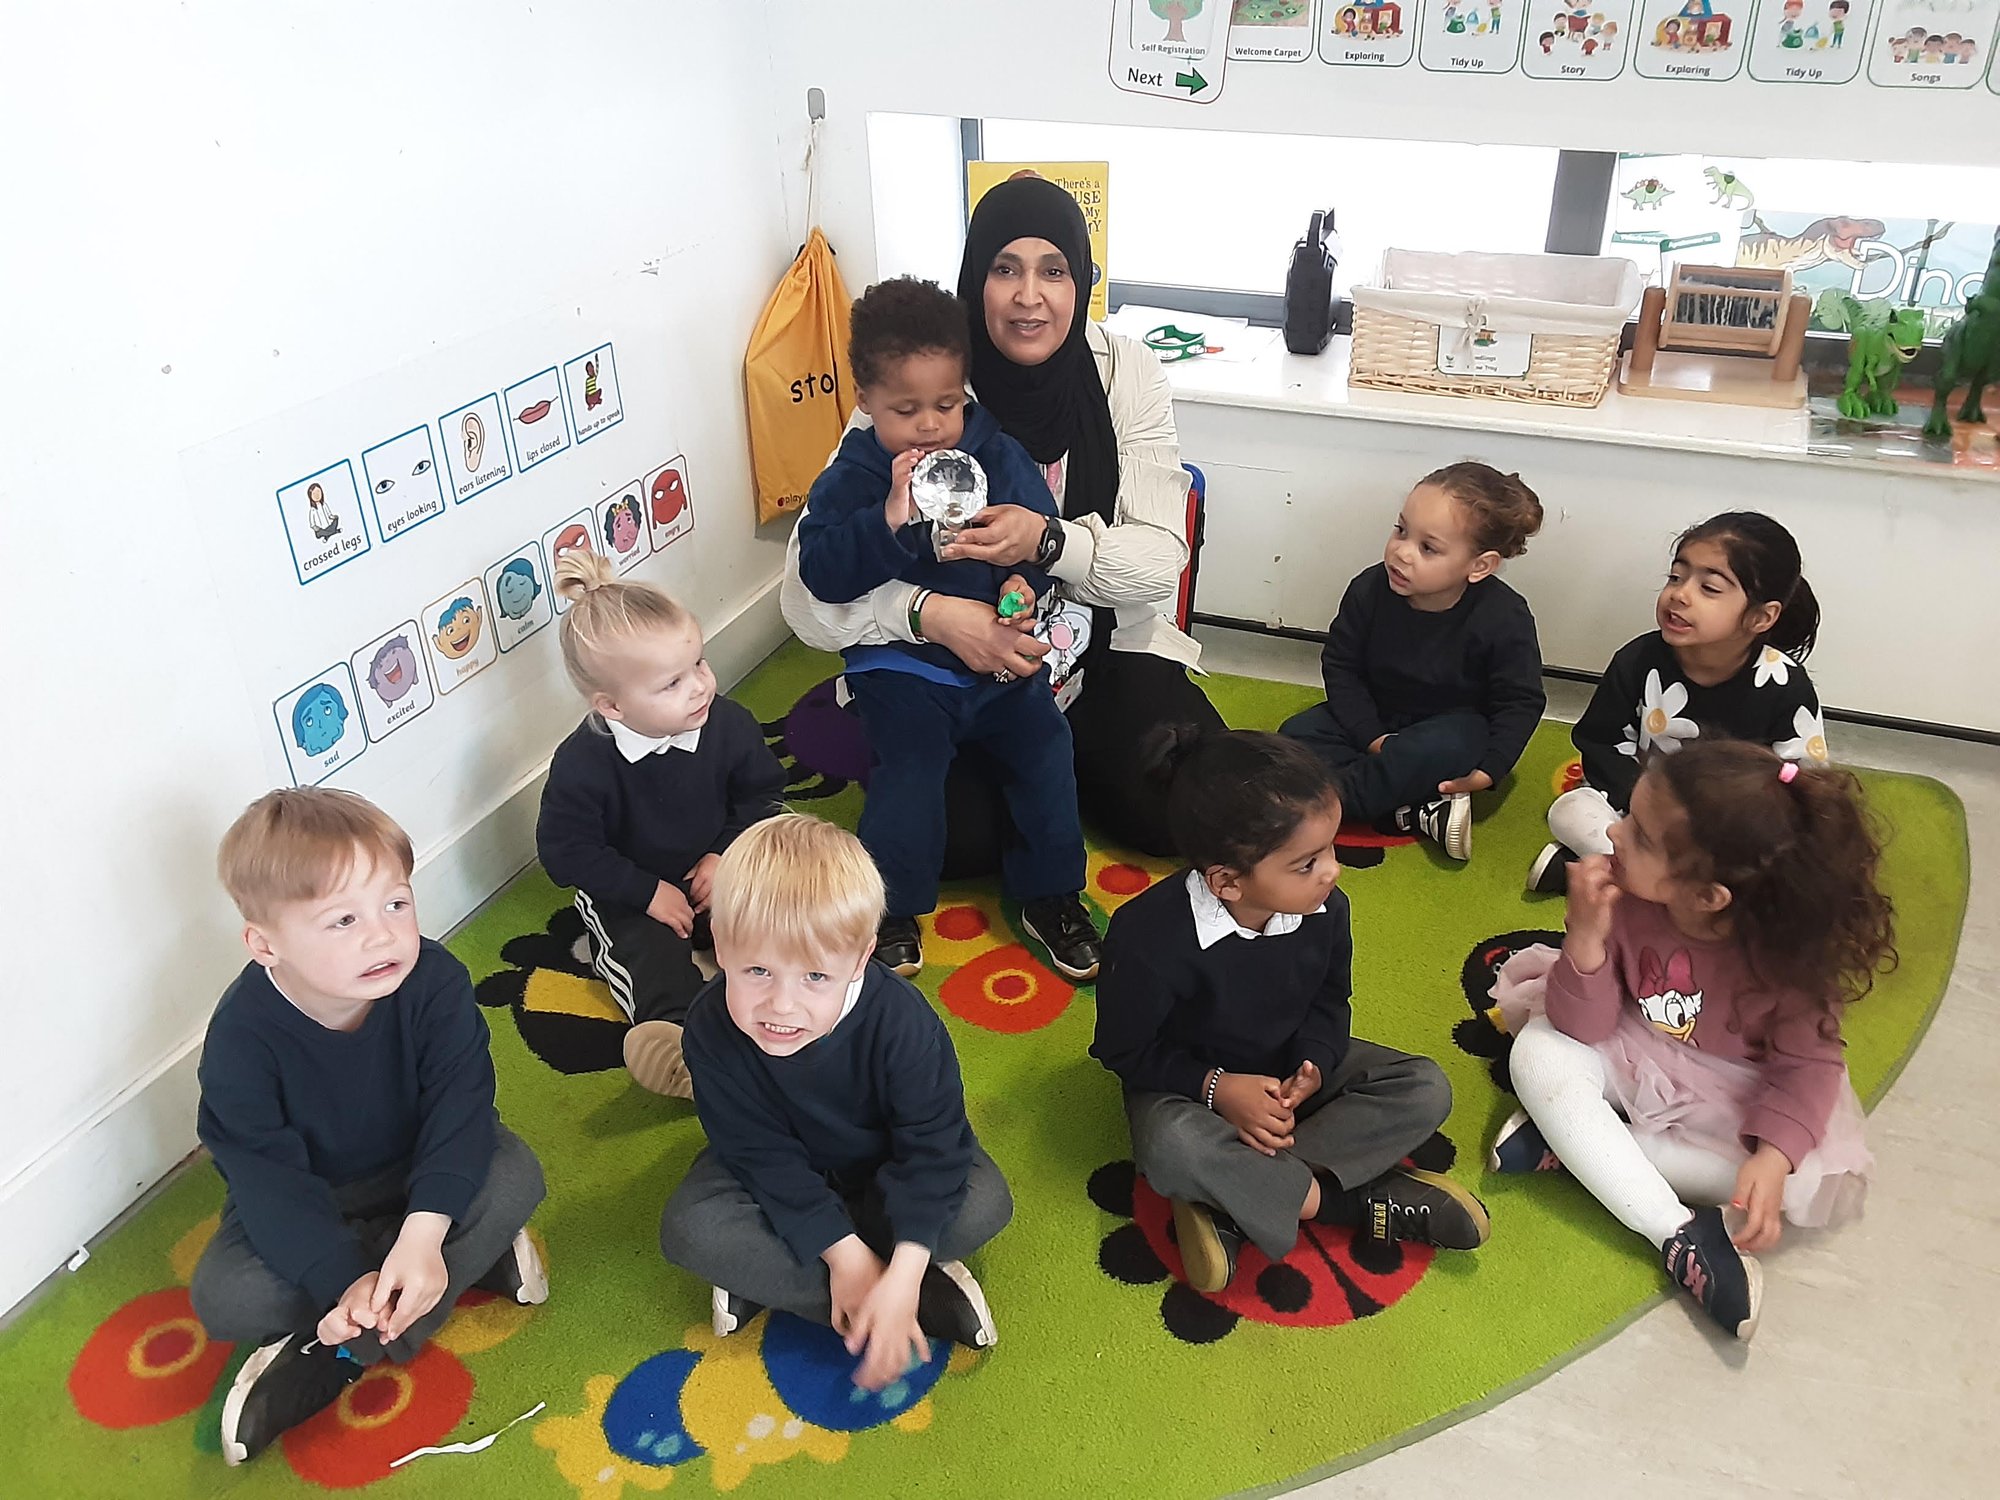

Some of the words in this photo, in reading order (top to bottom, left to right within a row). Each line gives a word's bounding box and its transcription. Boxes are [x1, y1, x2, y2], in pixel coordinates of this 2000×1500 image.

[1141, 44, 1157, 53] Self
[1158, 44, 1206, 56] Registration
[1235, 47, 1272, 56] Welcome
[1274, 48, 1302, 57] Carpet
[1345, 51, 1385, 62] Exploring
[1451, 57, 1470, 68] Tidy
[1471, 58, 1484, 68] Up
[1127, 67, 1163, 87] Next
[1561, 65, 1586, 75] Story
[1666, 64, 1711, 76] Exploring
[1786, 67, 1806, 79] Tidy
[1808, 69, 1823, 79] Up
[1910, 73, 1941, 84] Songs
[1055, 177, 1091, 189] There's
[1094, 180, 1100, 188] a
[1073, 190, 1101, 205] USE
[1085, 206, 1101, 220] My
[526, 448, 539, 462] lips
[540, 436, 561, 454] closed
[458, 482, 475, 495] ears
[475, 464, 507, 486] listening
[387, 515, 406, 533] eyes
[406, 500, 437, 521] looking
[303, 543, 340, 571] crossed
[341, 535, 362, 552] legs
[517, 620, 534, 634] calm
[456, 658, 479, 677] happy
[387, 700, 415, 725] excited
[324, 751, 341, 768] sad
